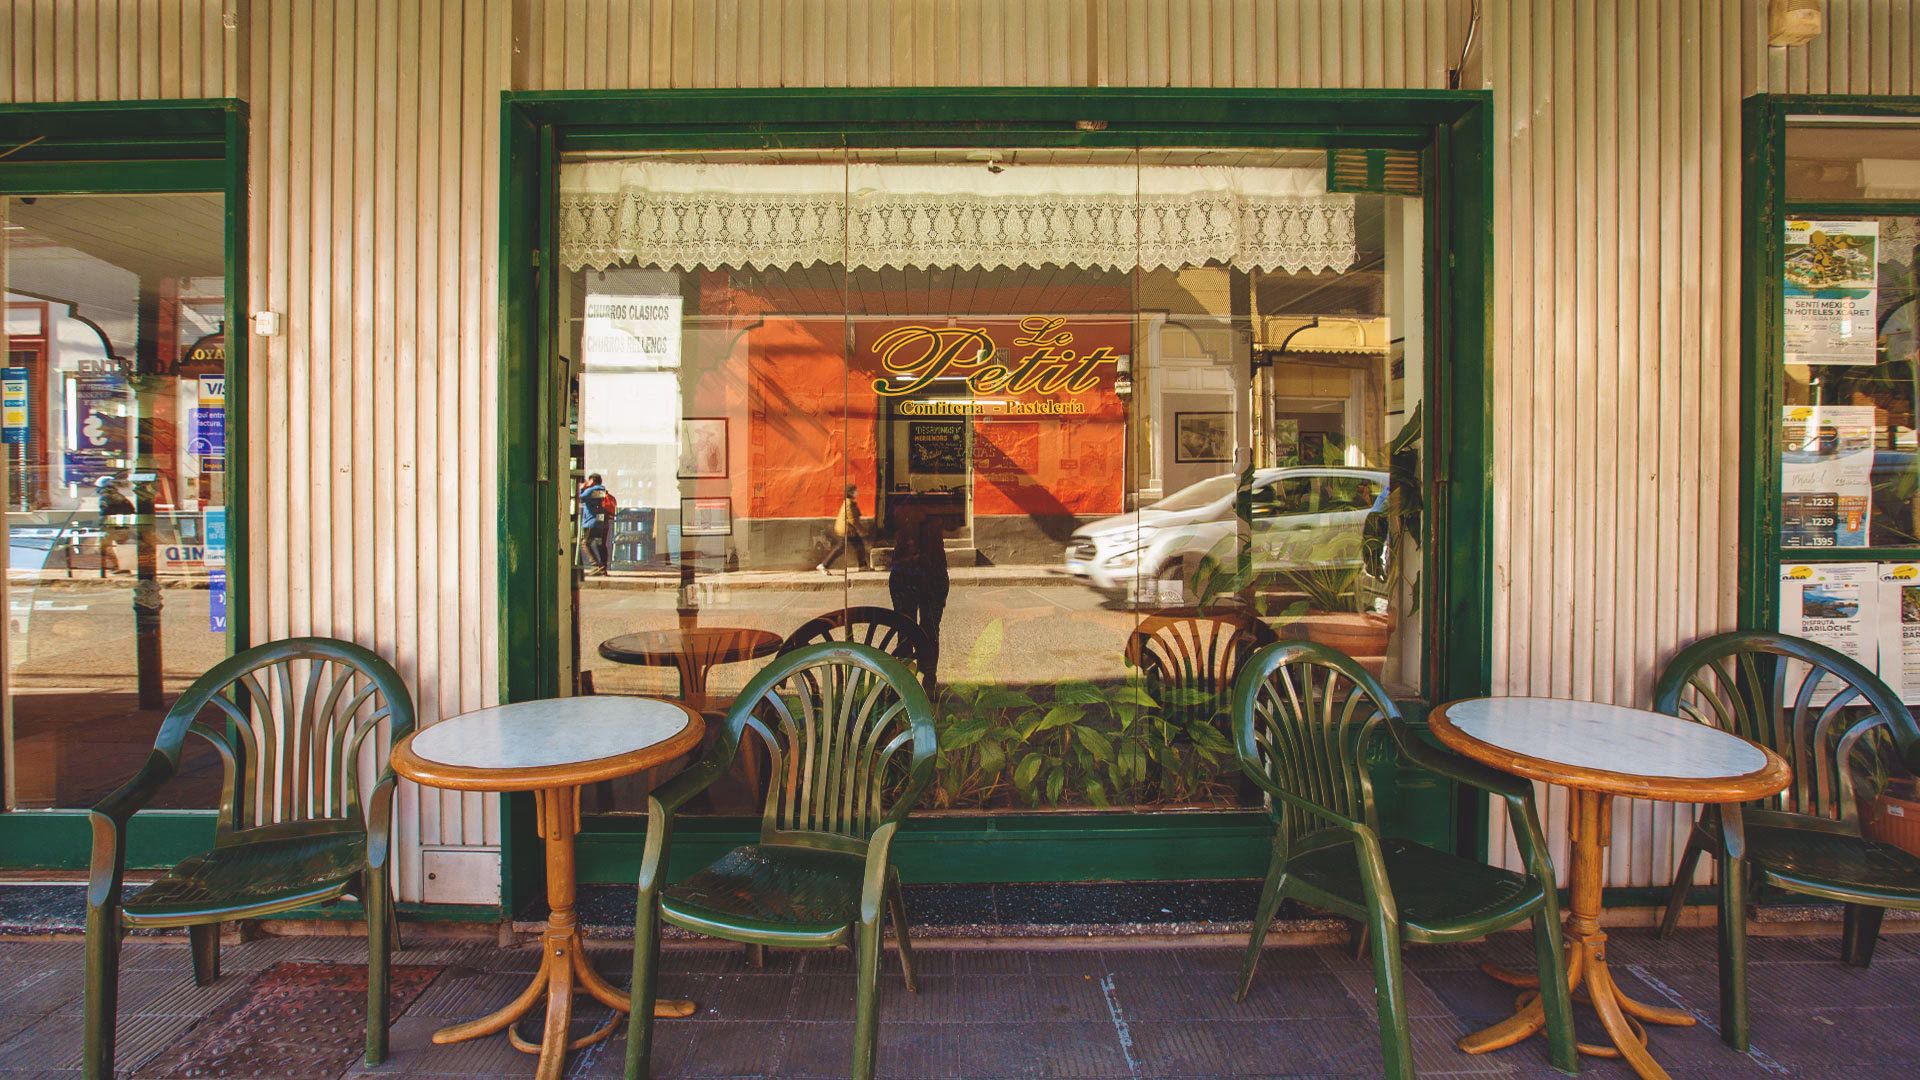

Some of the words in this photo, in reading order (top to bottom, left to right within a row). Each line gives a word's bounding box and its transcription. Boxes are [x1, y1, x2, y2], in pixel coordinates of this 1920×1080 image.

[587, 303, 627, 320] CHURROS
[629, 304, 670, 321] CLASICOS
[1794, 308, 1834, 316] HOTELES
[1013, 315, 1074, 346] Le
[871, 325, 1120, 397] Petit
[899, 399, 985, 416] Confitería
[1004, 398, 1084, 415] Pastelería
[1811, 498, 1834, 507] 1235
[1811, 517, 1834, 527] 1239
[1812, 537, 1834, 546] 1395
[1801, 624, 1852, 633] BARILOCHE
